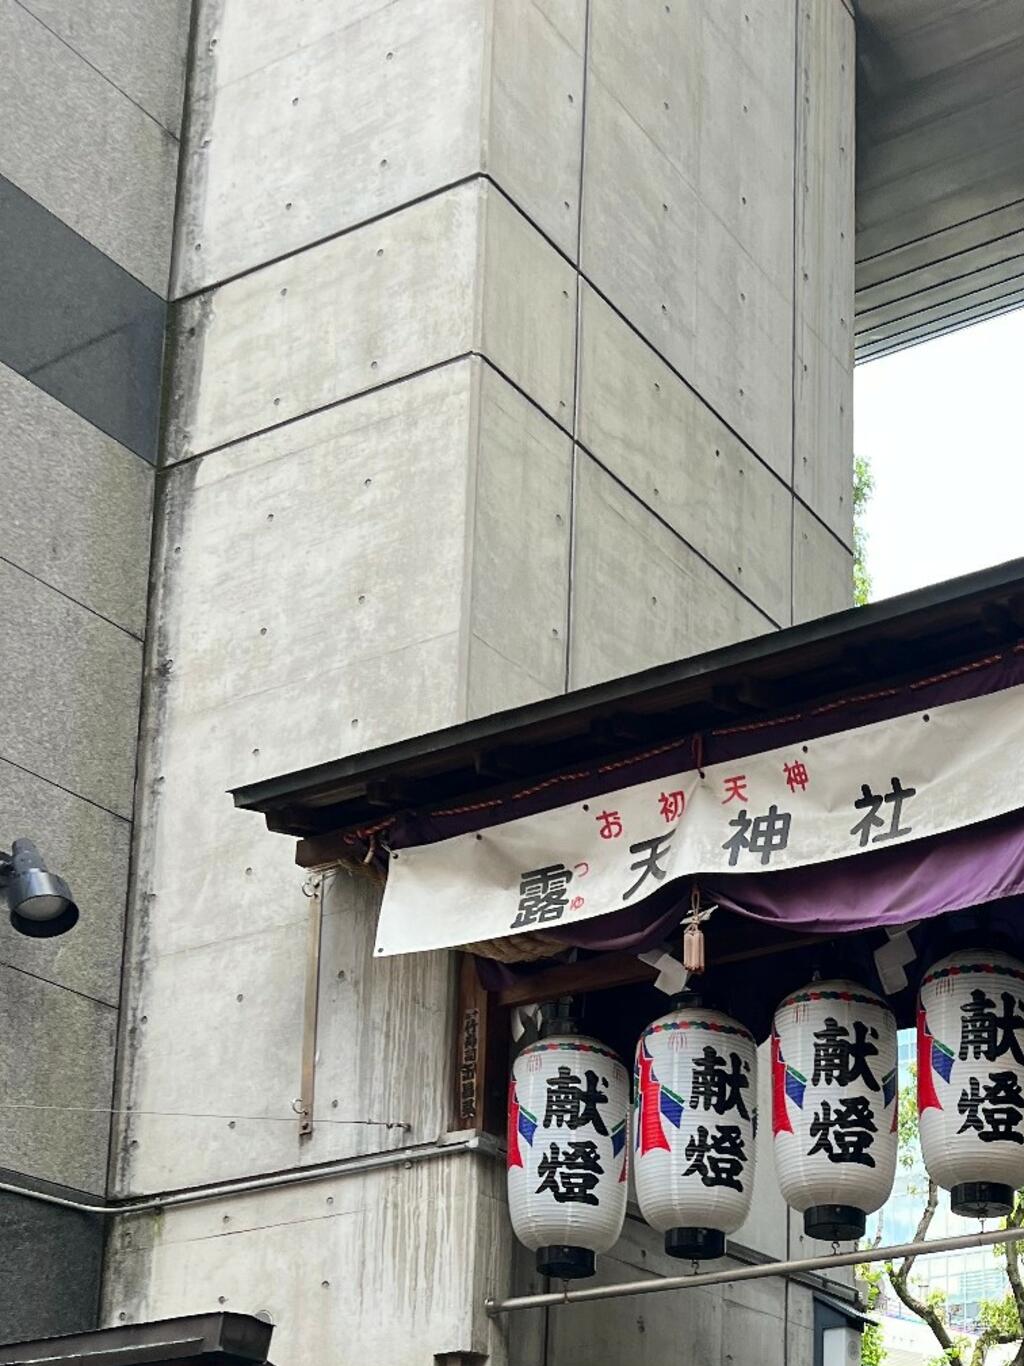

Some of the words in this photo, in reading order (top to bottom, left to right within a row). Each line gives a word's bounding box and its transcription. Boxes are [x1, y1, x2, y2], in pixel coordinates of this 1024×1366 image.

[510, 777, 916, 929] 露天神社
[595, 759, 809, 841] お初天神
[535, 1066, 610, 1206] 献燈
[681, 1045, 752, 1192] 献燈
[807, 1017, 882, 1168] 献燈
